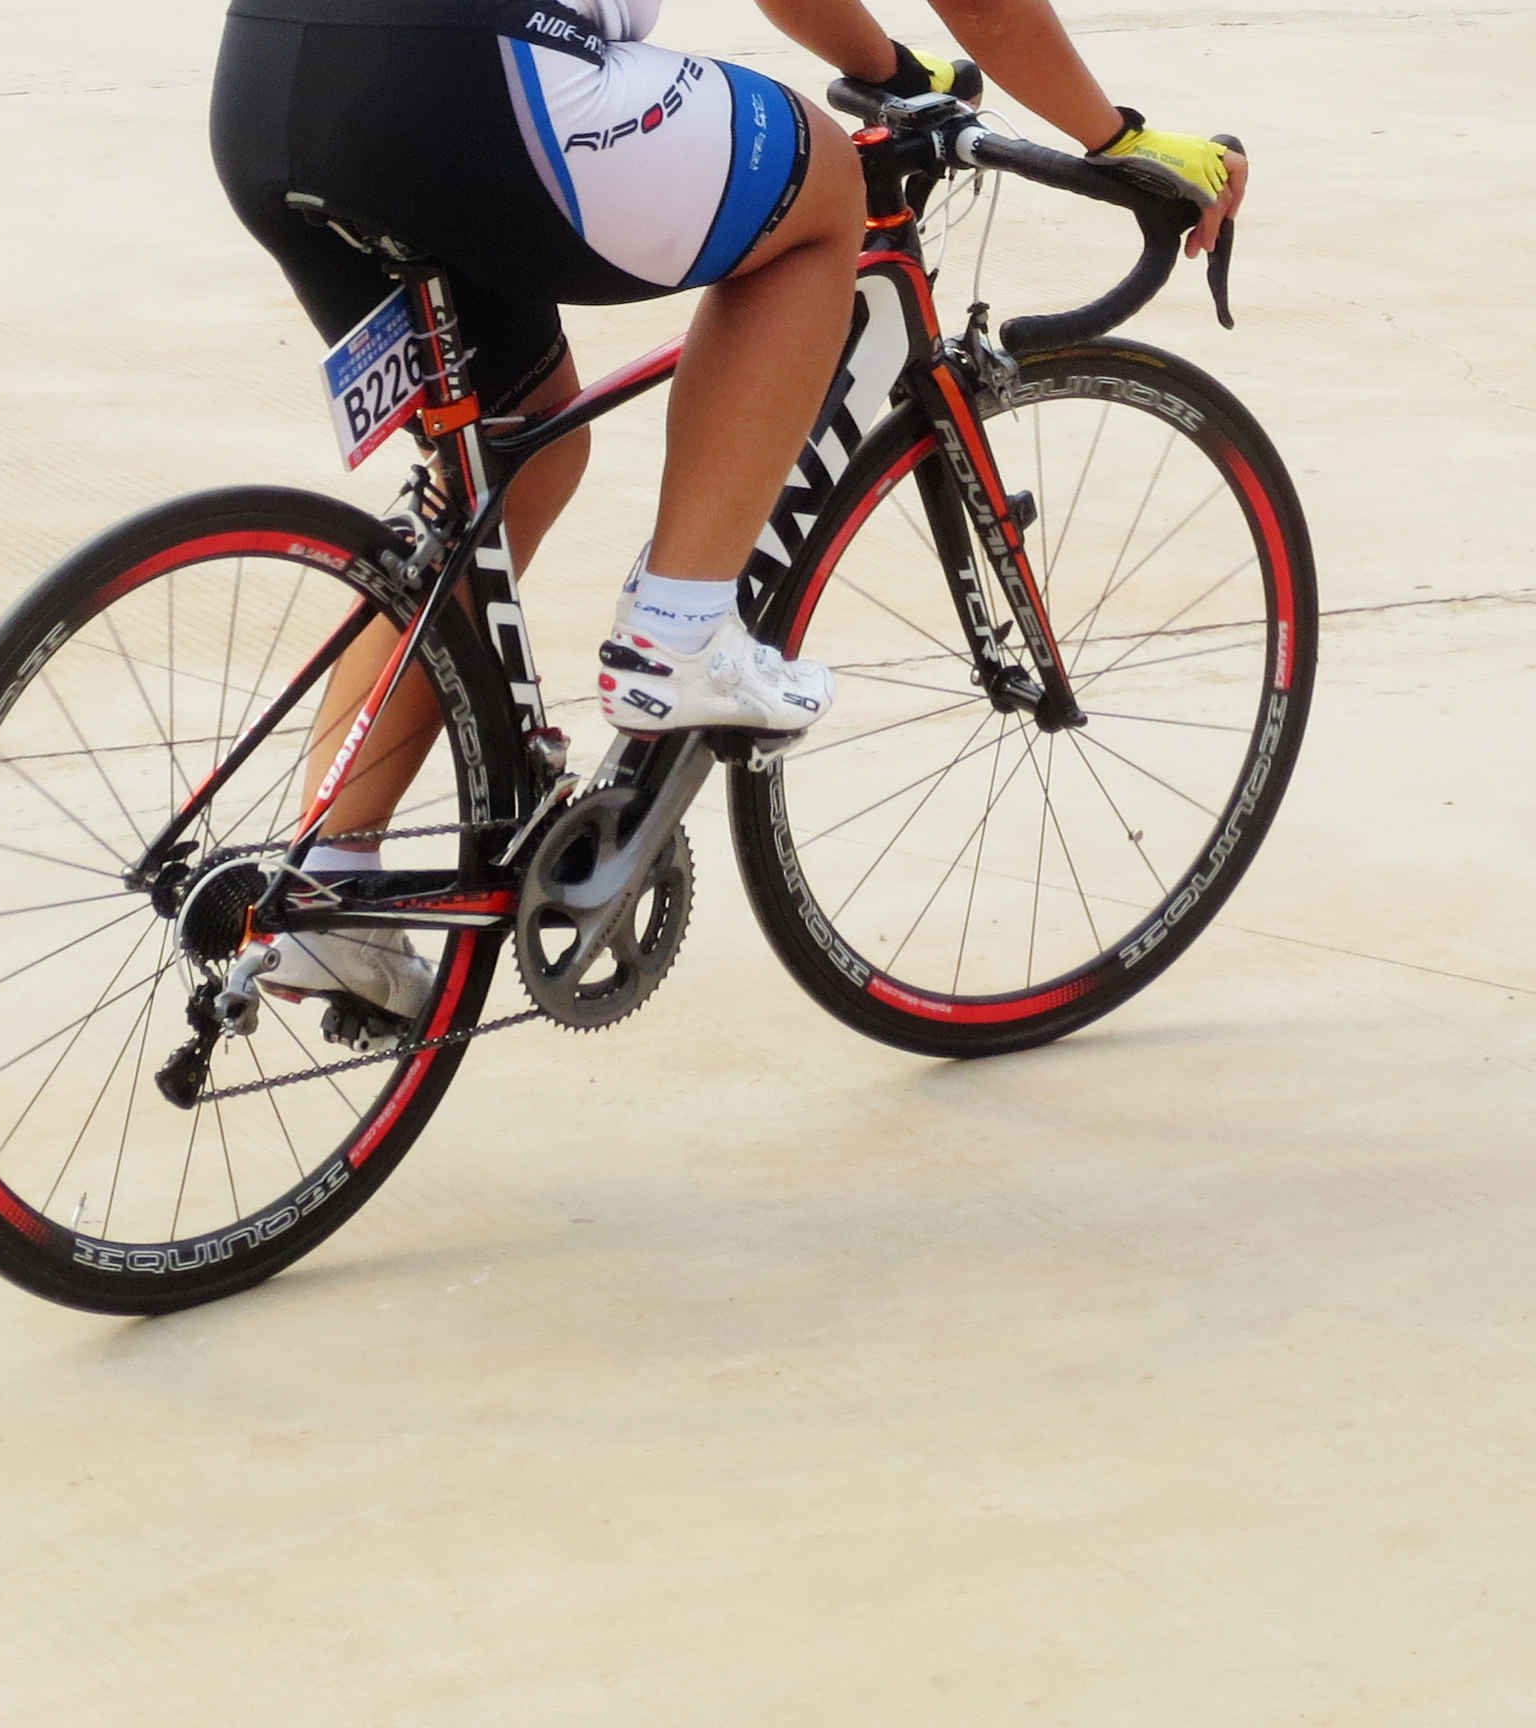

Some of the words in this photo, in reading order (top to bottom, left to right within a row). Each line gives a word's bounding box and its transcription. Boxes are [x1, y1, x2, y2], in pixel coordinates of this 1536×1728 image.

[935, 419, 1054, 668] ADVANCED
[958, 555, 999, 663] TCR
[318, 706, 371, 802] GIANT
